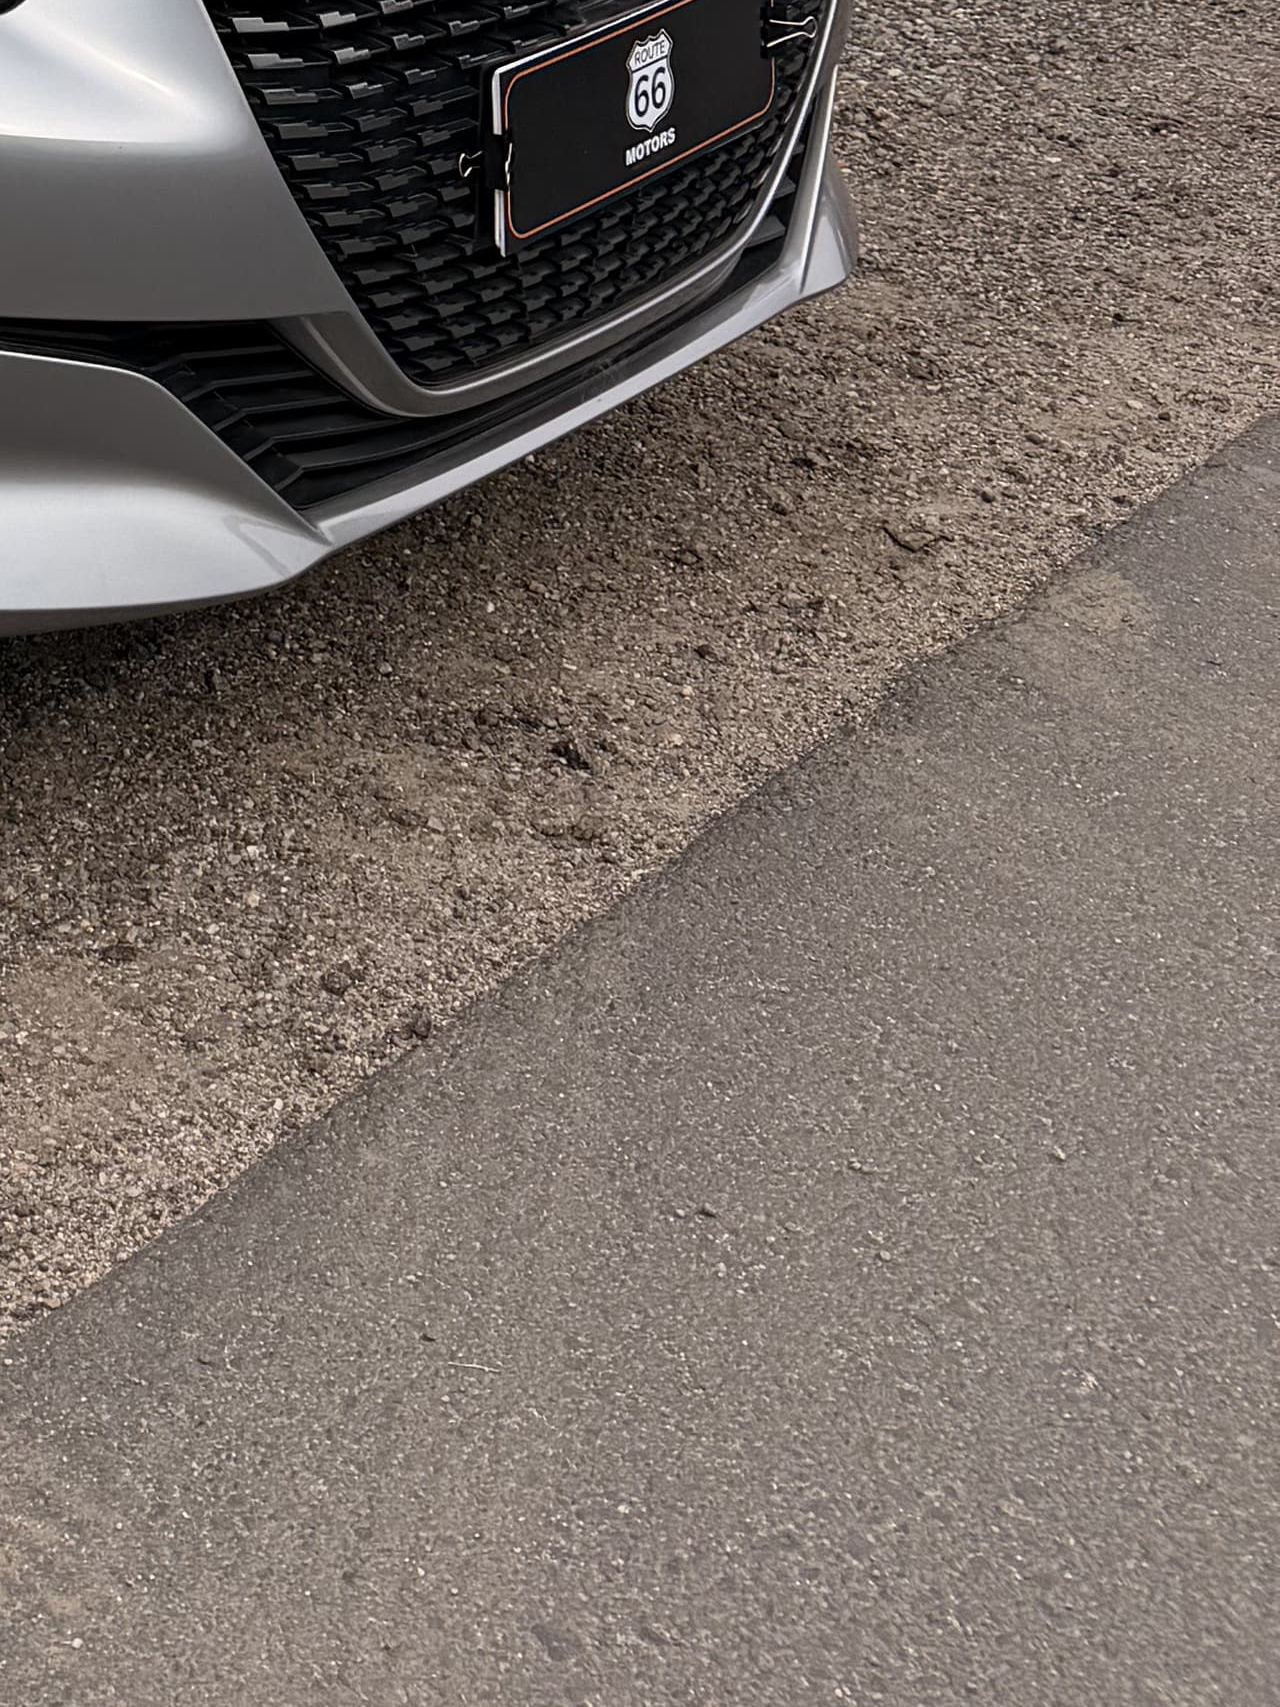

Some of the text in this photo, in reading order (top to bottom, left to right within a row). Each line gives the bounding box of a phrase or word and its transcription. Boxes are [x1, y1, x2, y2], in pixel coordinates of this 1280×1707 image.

[634, 40, 666, 64] ROUTE
[634, 66, 666, 118] 66
[625, 127, 676, 166] MOTORS
